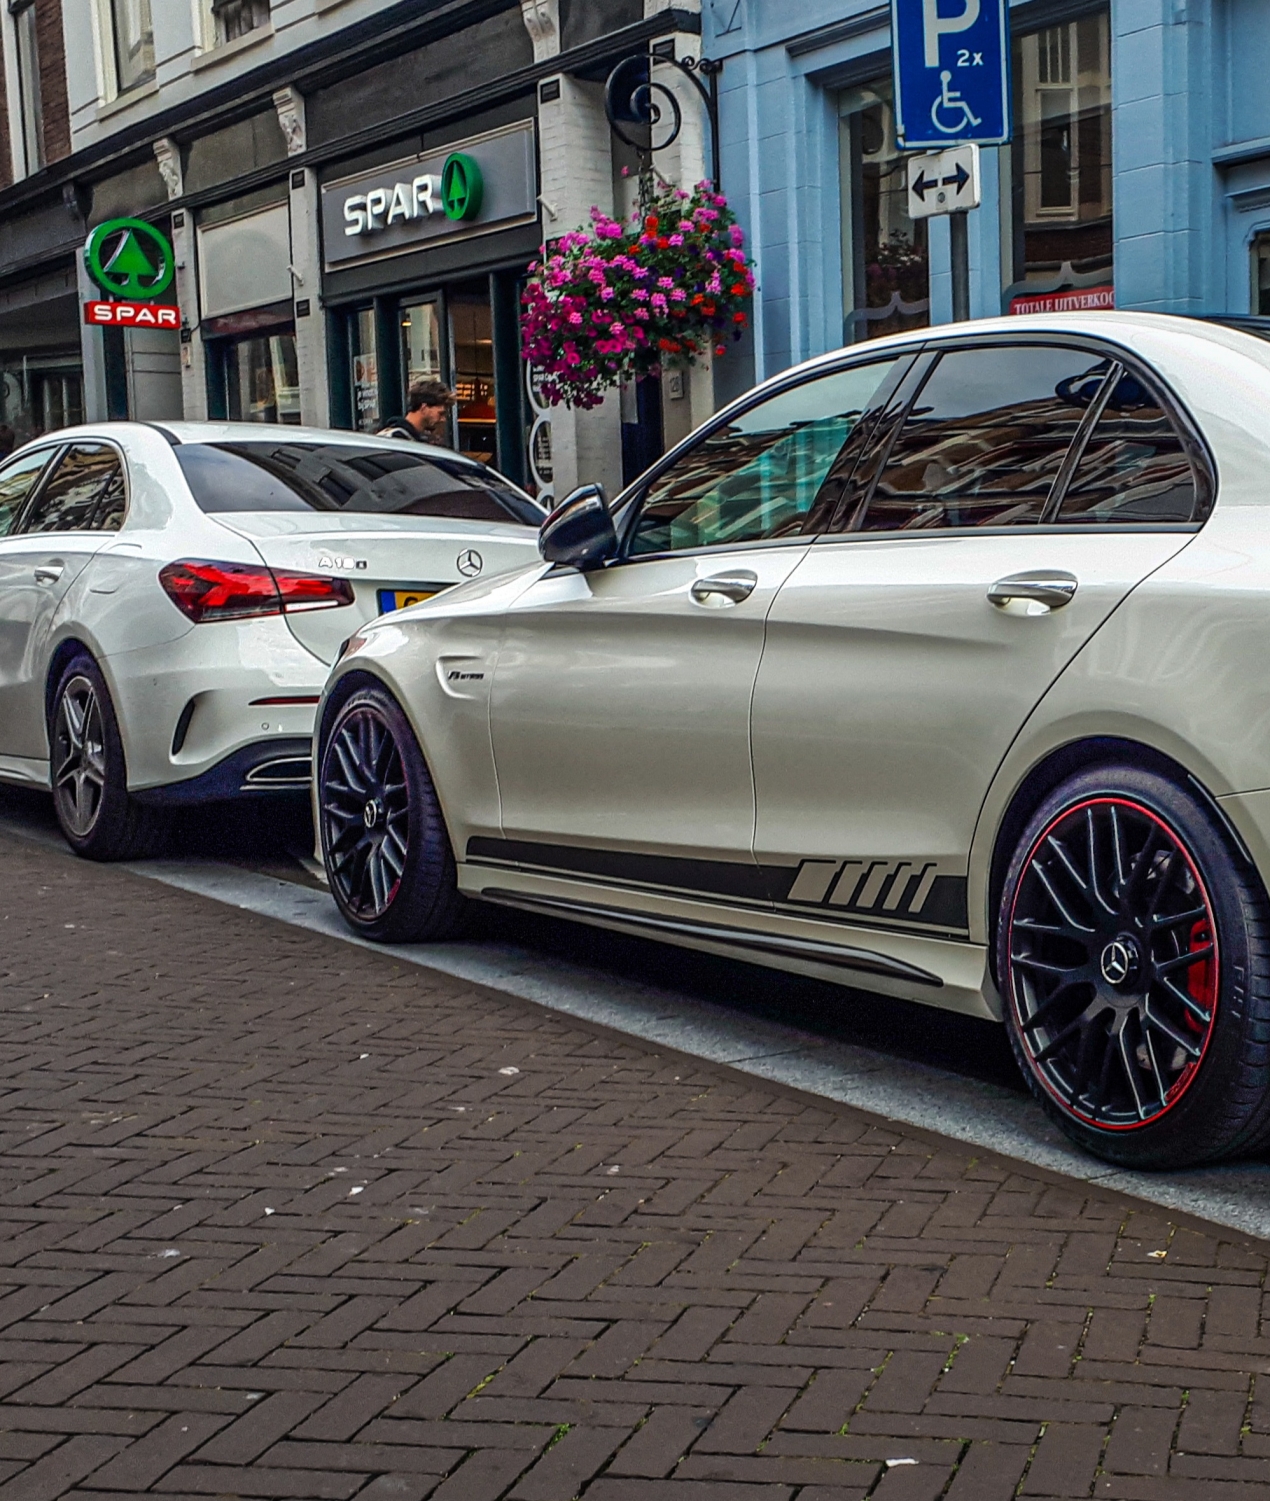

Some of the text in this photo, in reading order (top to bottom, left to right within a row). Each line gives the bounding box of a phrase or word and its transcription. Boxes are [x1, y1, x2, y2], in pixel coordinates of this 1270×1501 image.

[923, 0, 980, 68] P
[957, 49, 984, 67] 2x
[343, 174, 440, 236] SPAR
[94, 304, 177, 325] SPAR
[1014, 299, 1054, 315] TOTALE
